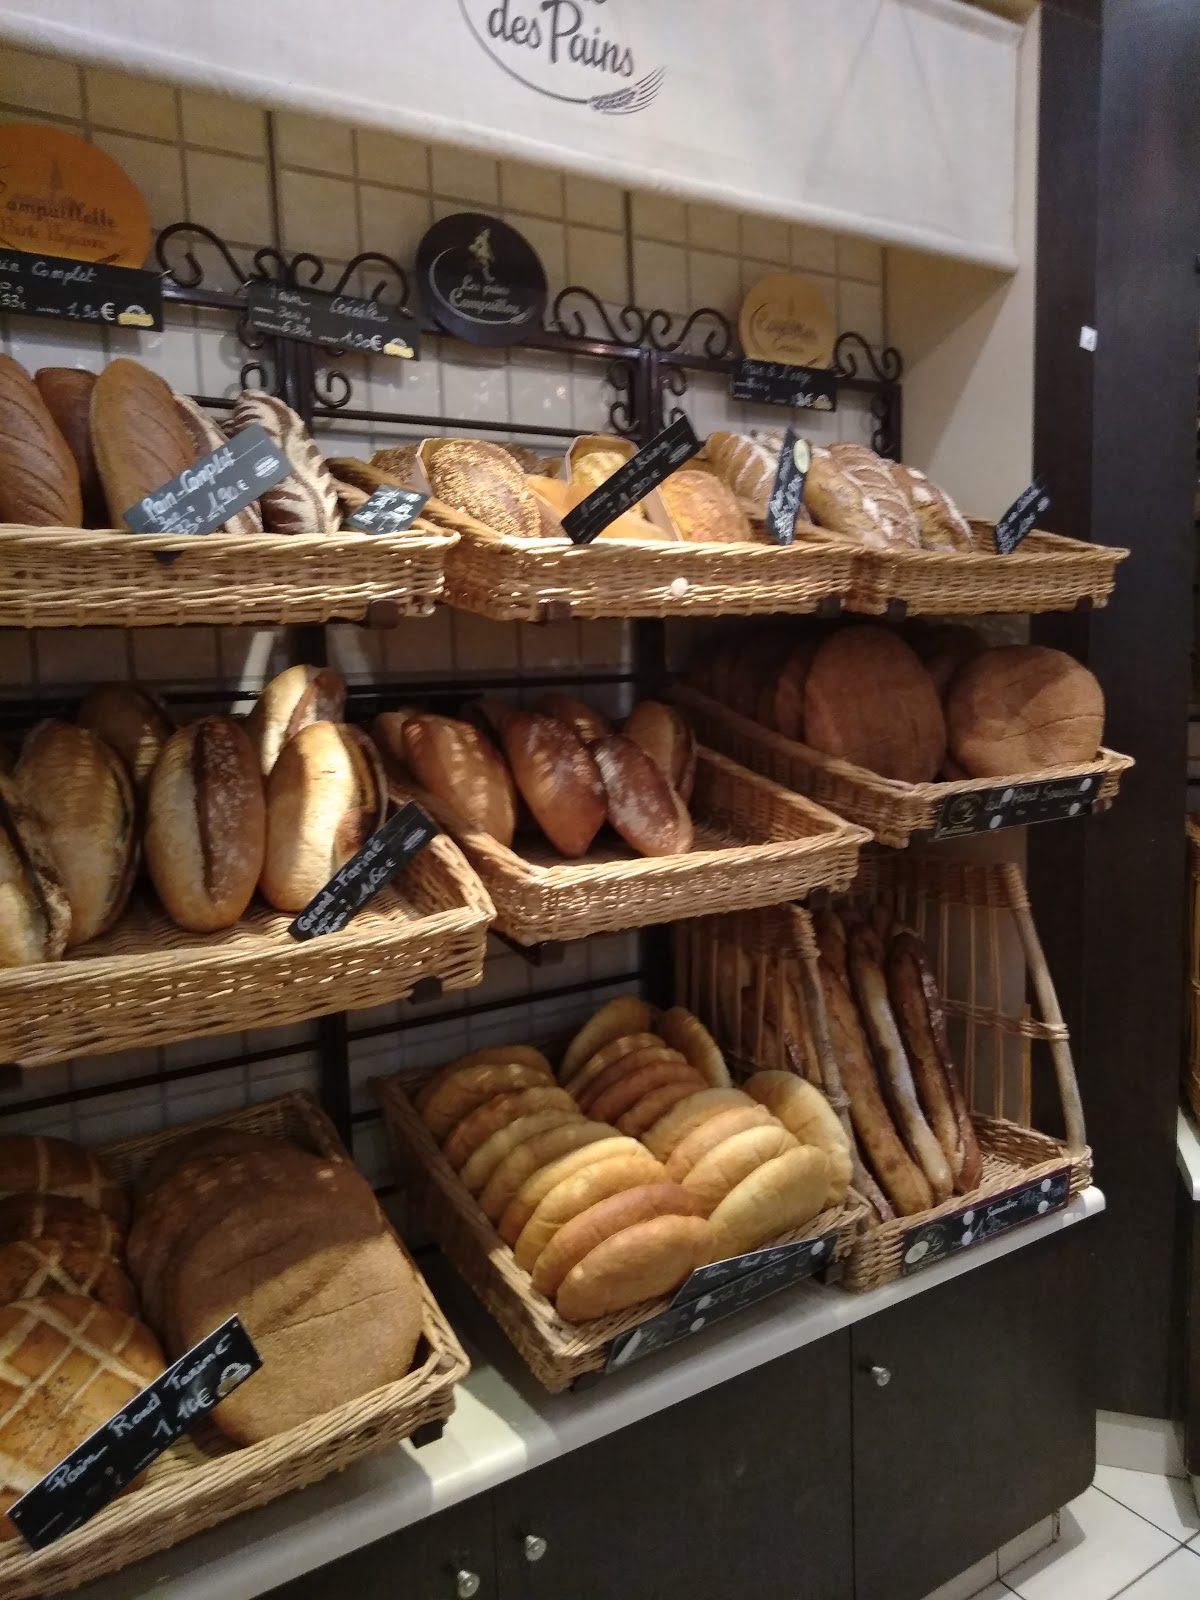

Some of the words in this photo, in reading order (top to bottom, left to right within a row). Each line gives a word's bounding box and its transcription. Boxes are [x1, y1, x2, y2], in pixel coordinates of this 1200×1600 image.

[488, 0, 542, 49] des
[541, 0, 634, 77] Pains
[45, 1445, 109, 1493] Pain
